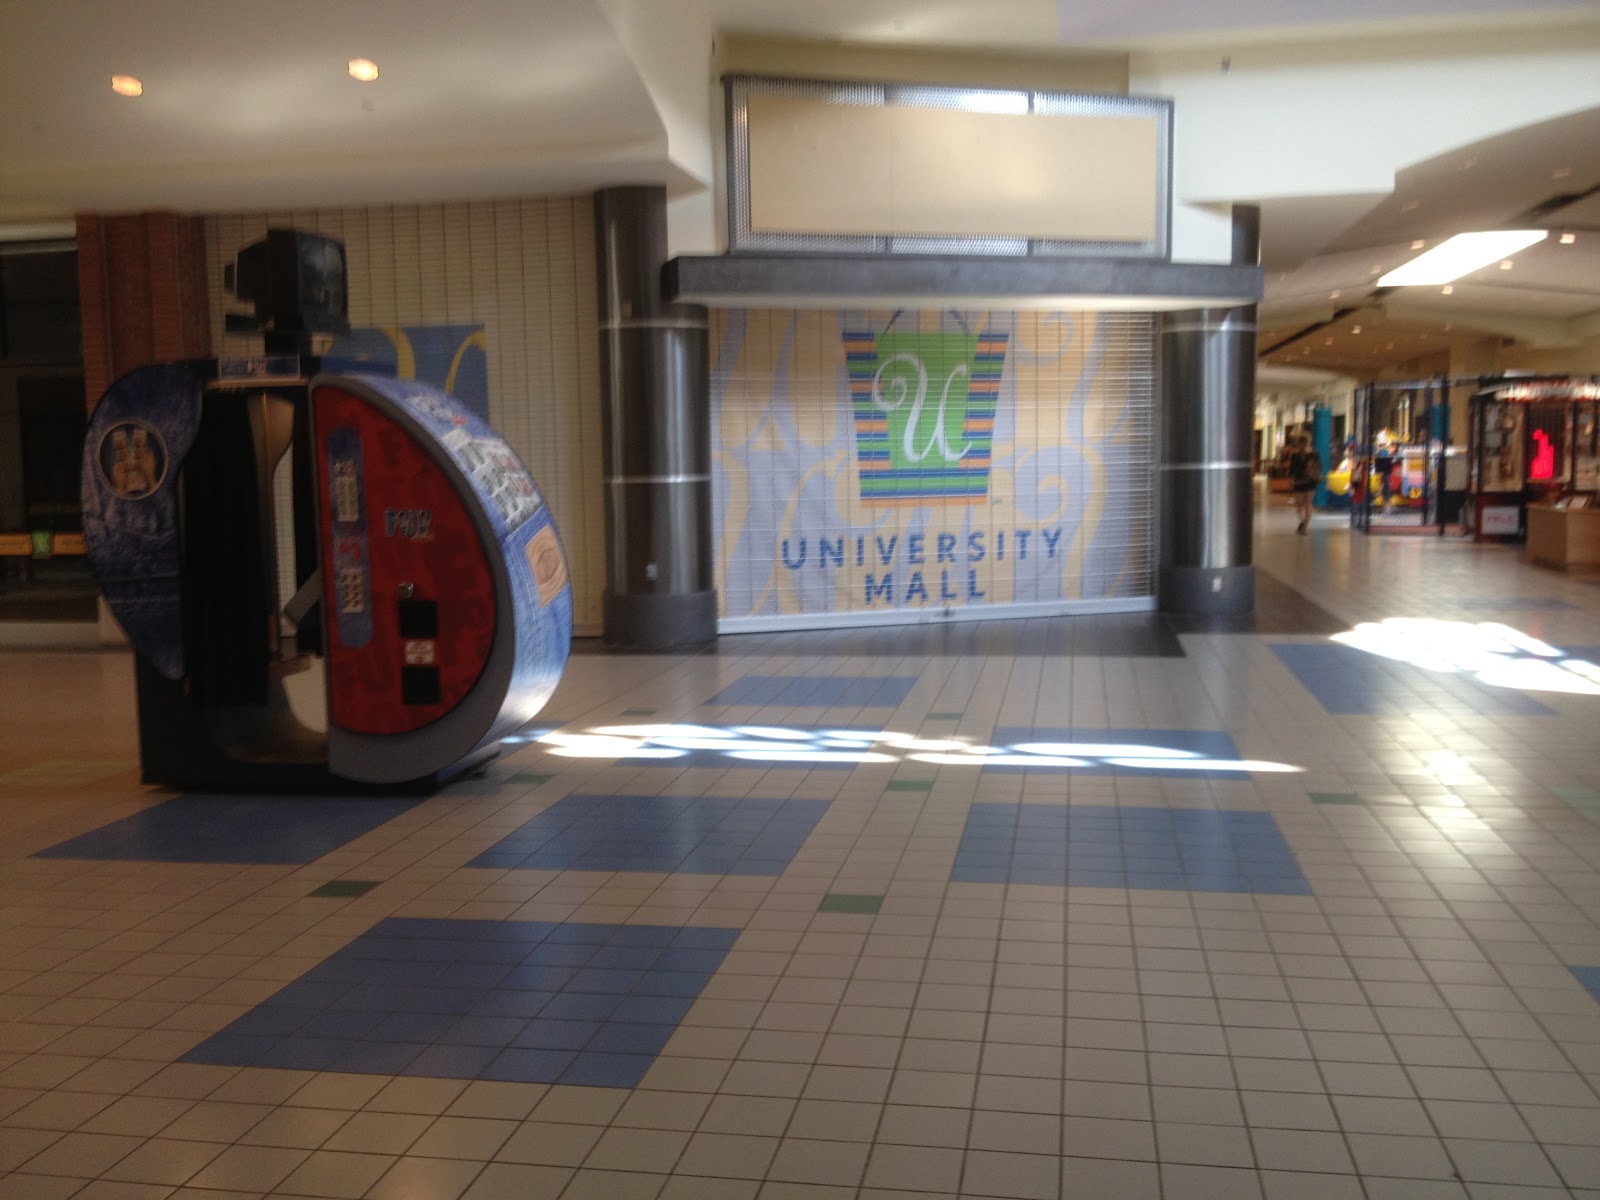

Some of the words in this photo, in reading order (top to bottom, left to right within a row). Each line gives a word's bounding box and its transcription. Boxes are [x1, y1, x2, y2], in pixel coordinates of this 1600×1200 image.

[872, 353, 973, 462] U
[782, 529, 1062, 570] UNIVERSITY
[865, 570, 986, 604] MALL
